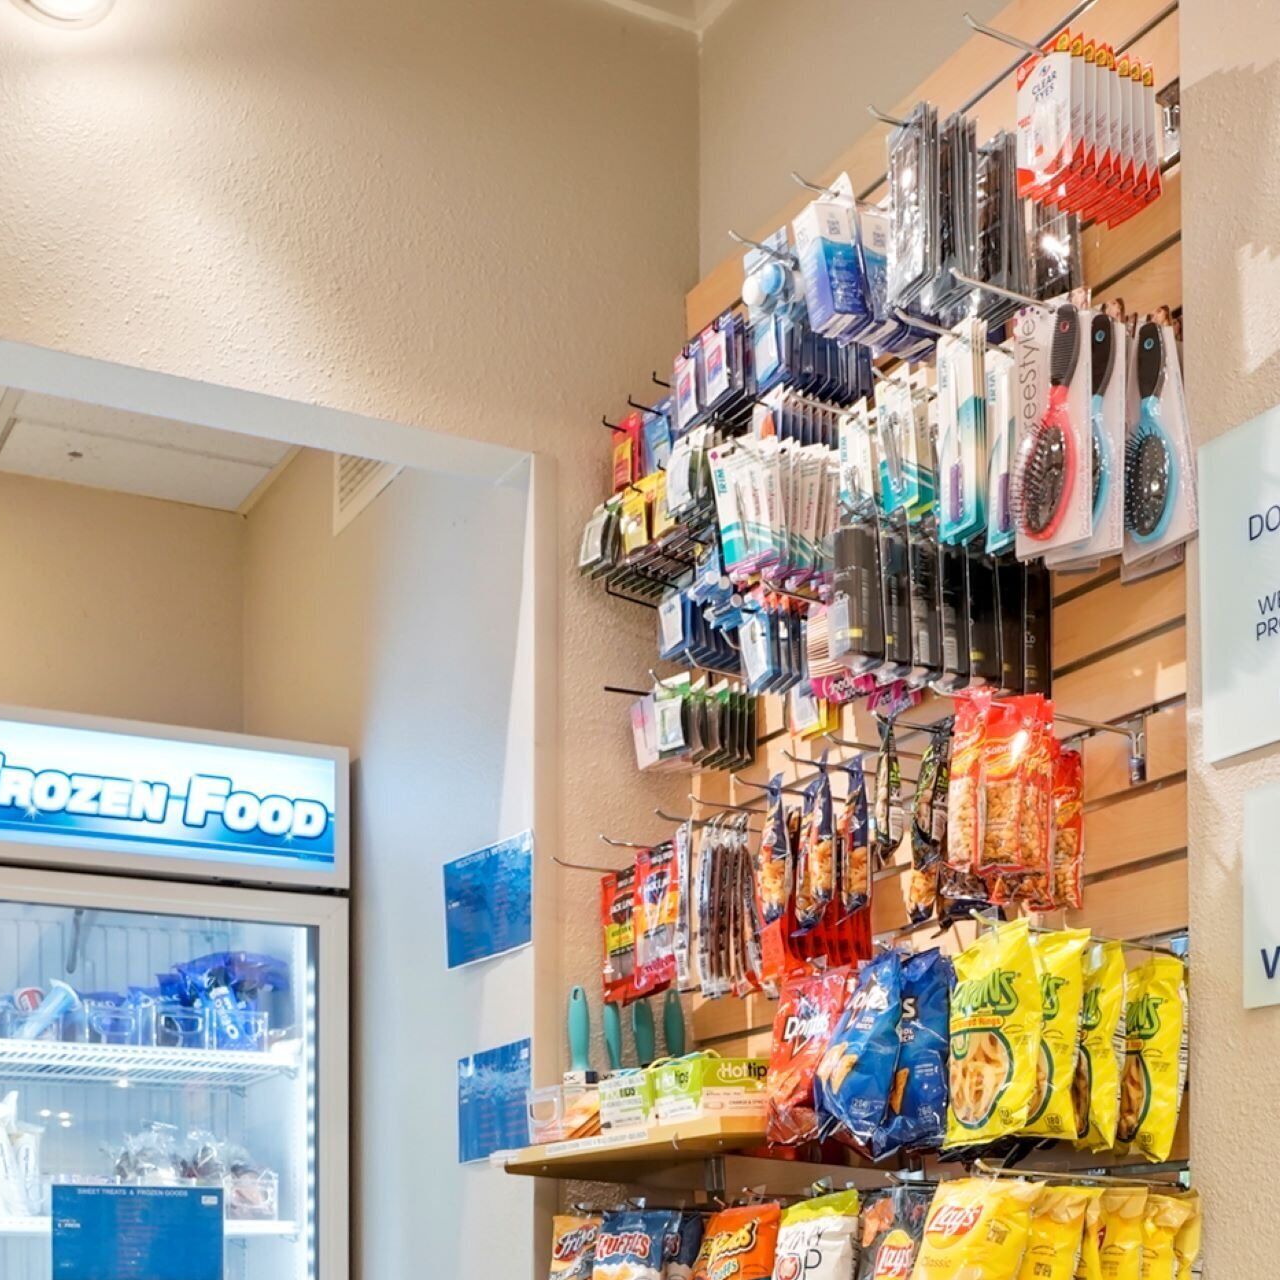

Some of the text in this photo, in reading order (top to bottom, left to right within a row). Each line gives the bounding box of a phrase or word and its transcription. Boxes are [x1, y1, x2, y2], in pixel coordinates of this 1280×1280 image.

[1032, 71, 1057, 95] CLEAR
[182, 775, 328, 839] FOOD
[721, 1062, 768, 1080] Hottip
